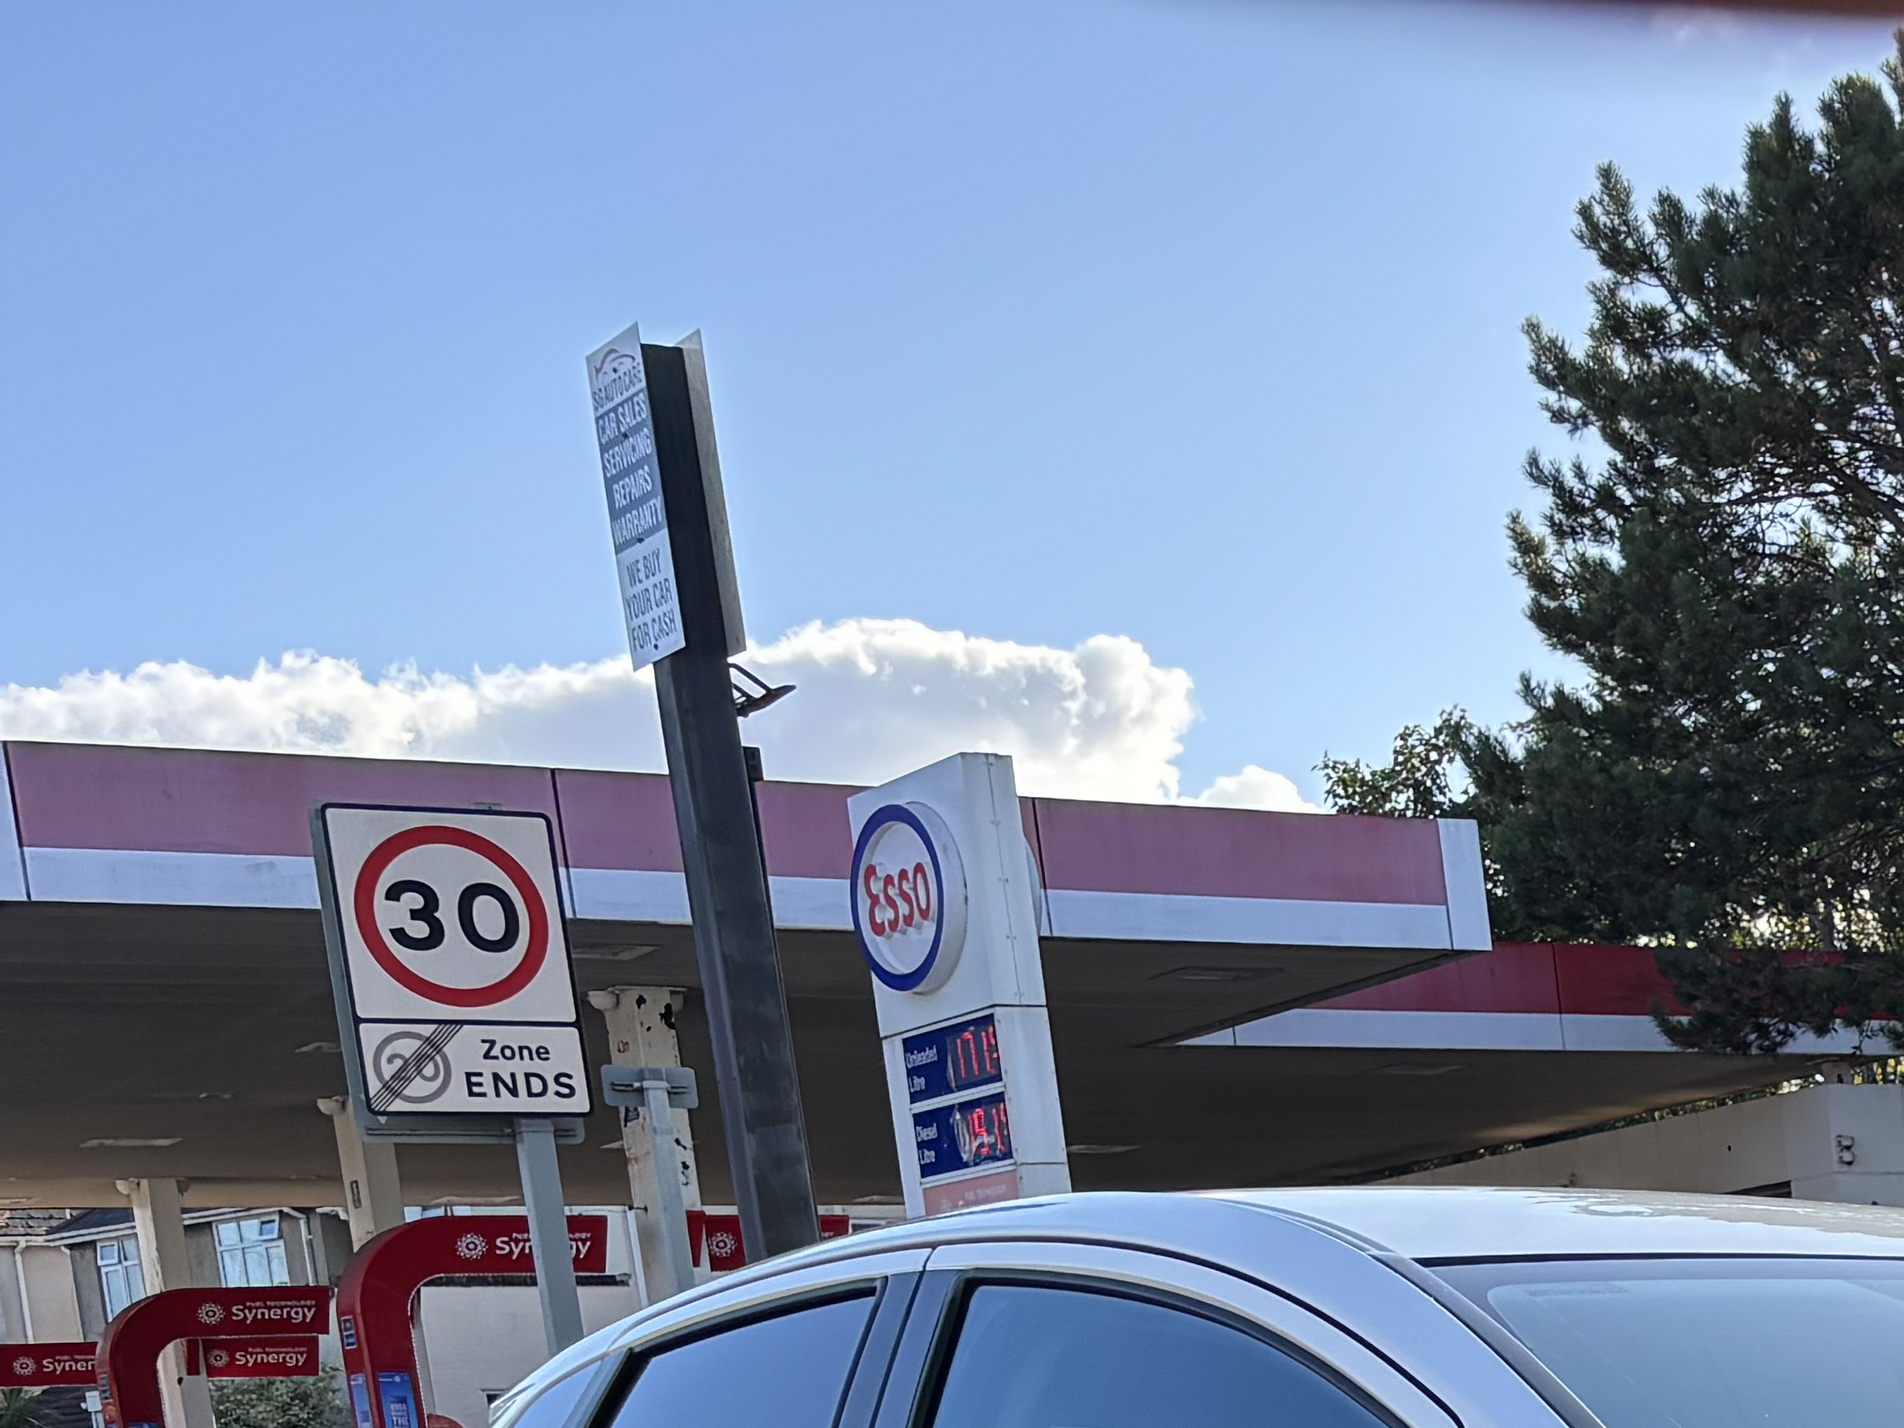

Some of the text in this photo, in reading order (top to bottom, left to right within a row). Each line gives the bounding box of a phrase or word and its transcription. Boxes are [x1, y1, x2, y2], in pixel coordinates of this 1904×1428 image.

[599, 392, 647, 444] CAR SALES
[603, 427, 652, 478] SERVICING
[612, 465, 652, 510] REPAIRS
[611, 495, 662, 546] WARRANTY
[626, 548, 661, 588] WE BUY
[625, 577, 673, 622] YOUR CAR
[631, 607, 677, 652] FOR CASH
[384, 879, 520, 954] 30
[864, 862, 930, 937] Esso
[480, 1039, 551, 1061] Zone
[905, 1045, 938, 1069] Unleaded
[464, 1071, 576, 1099] ENDS
[916, 1123, 938, 1142] Diesel
[232, 1305, 316, 1324] Synergy
[43, 1358, 96, 1375] Syner
[235, 1351, 308, 1367] Synergy
